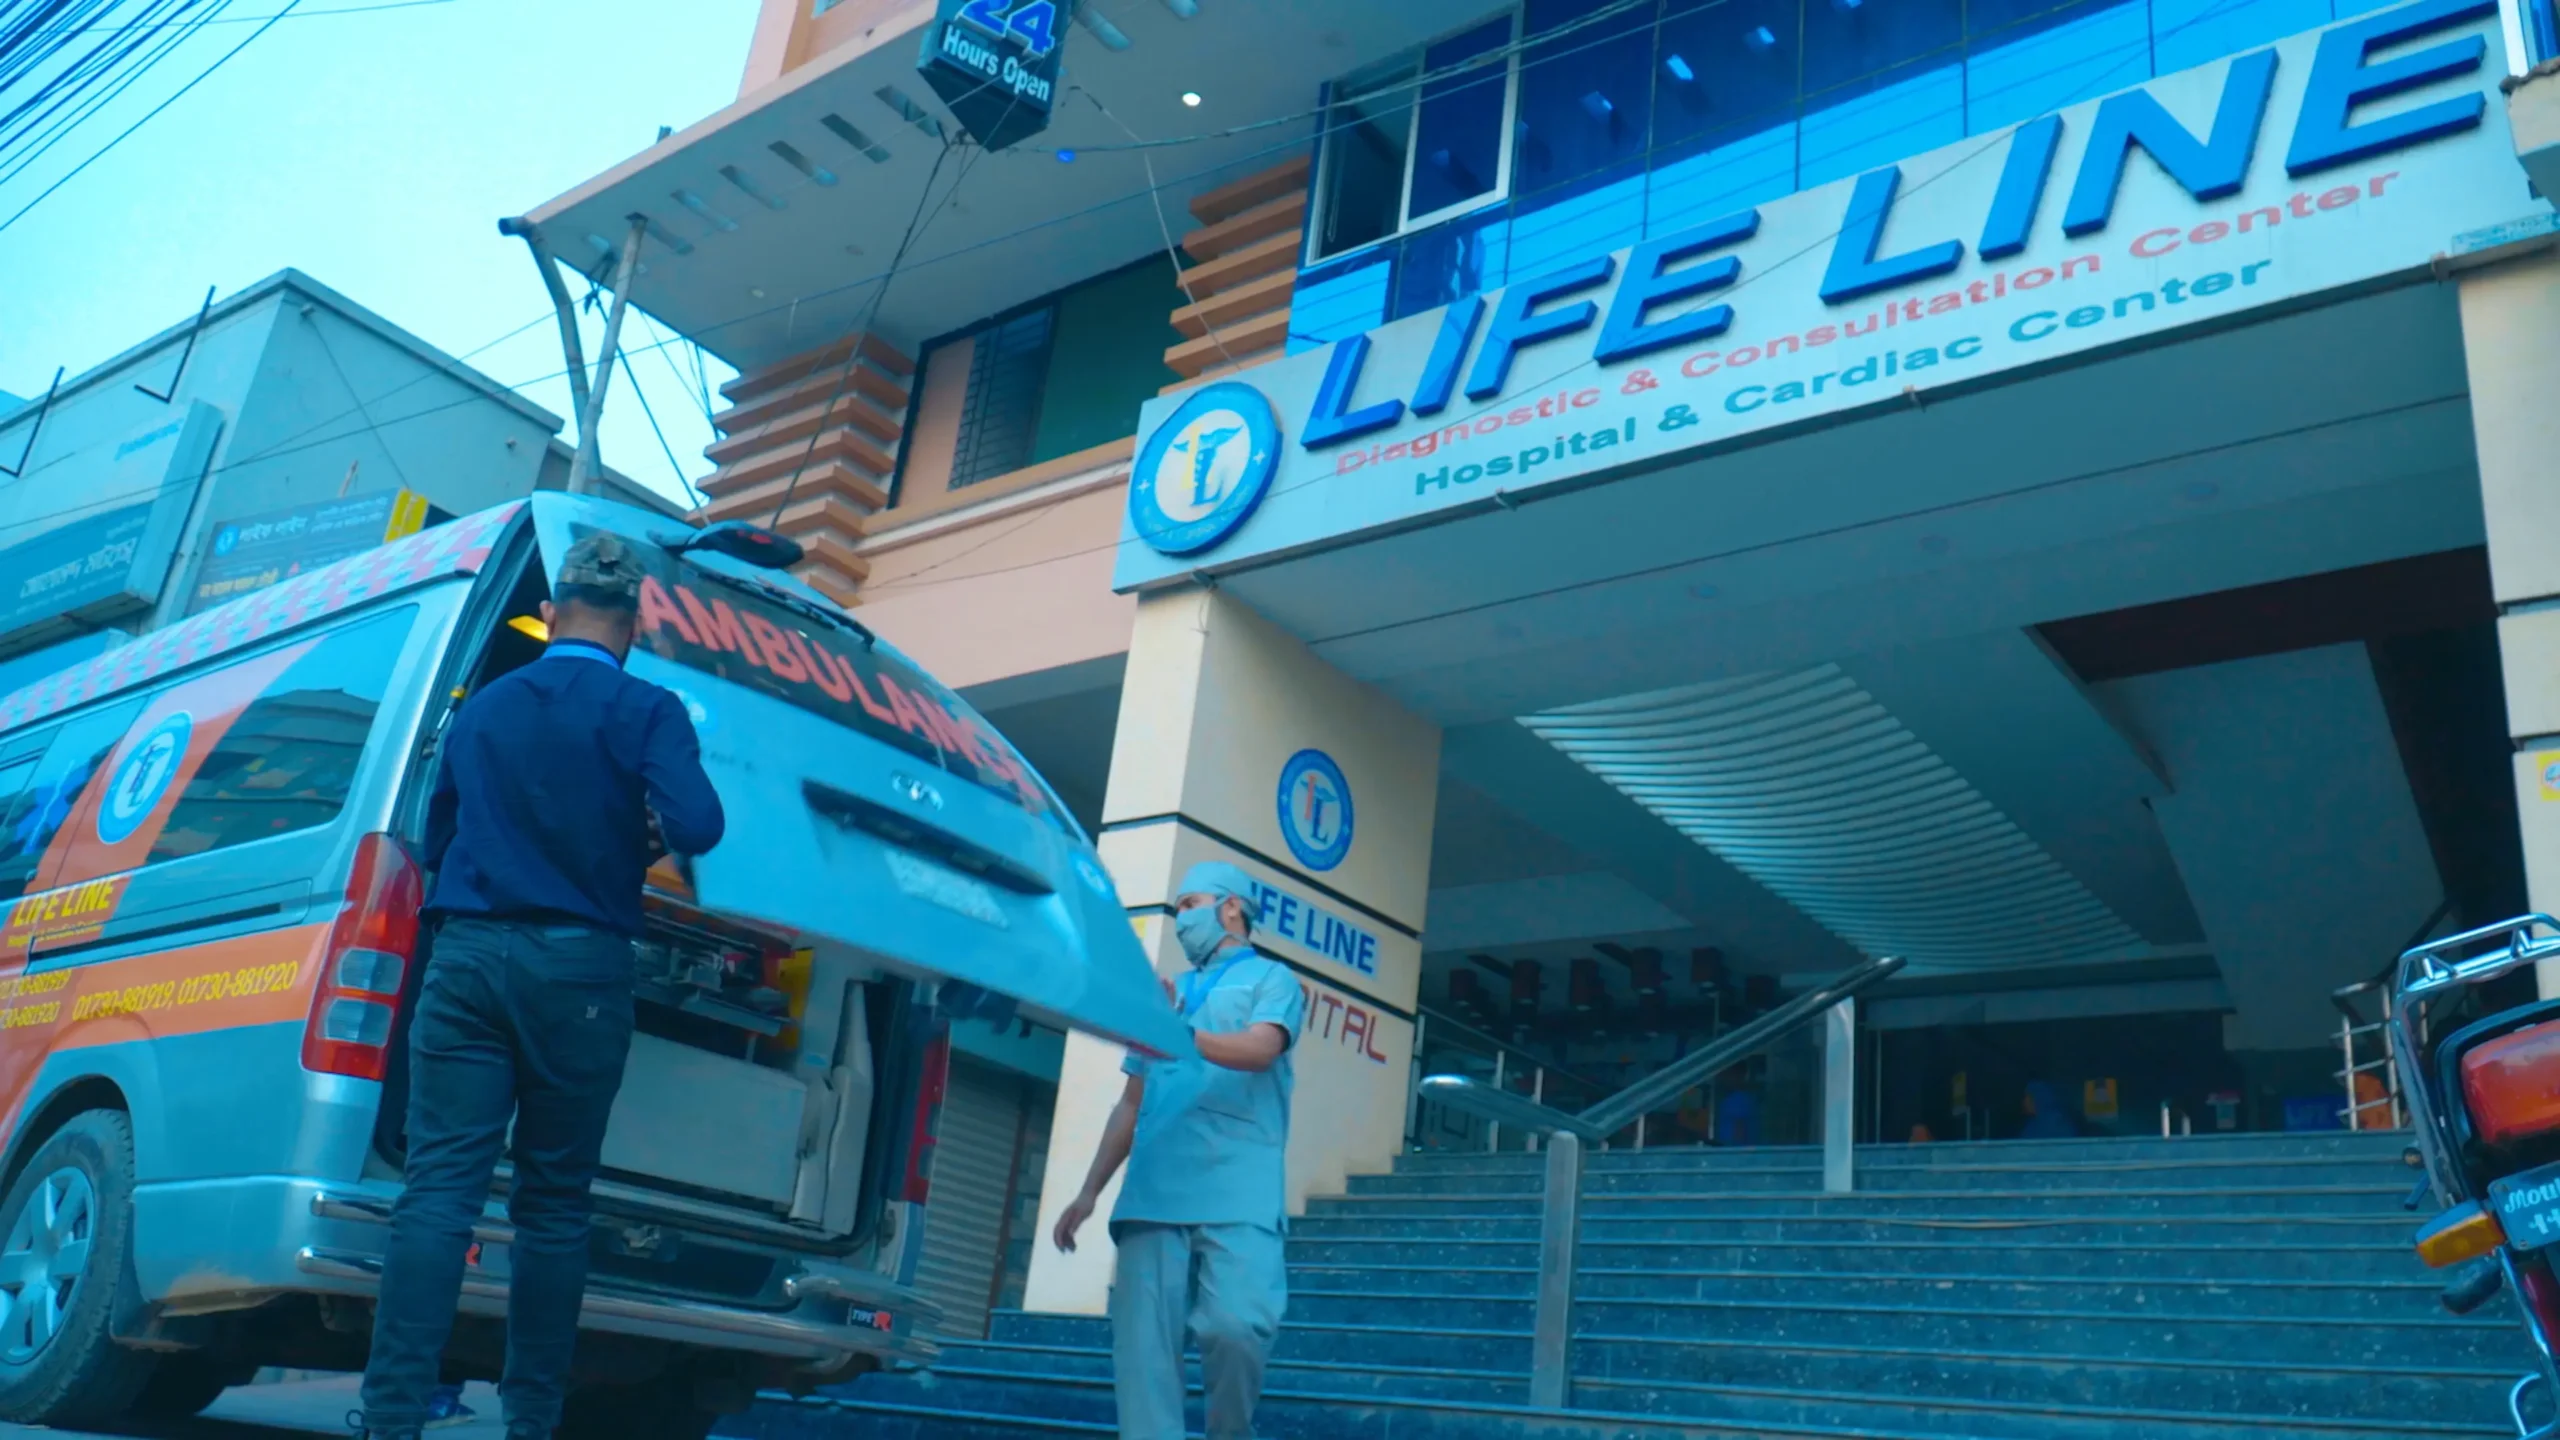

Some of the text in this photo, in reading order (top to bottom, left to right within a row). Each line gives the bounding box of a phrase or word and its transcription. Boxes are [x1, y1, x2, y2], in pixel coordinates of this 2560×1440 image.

[942, 25, 1050, 101] Hours Open
[955, 0, 1056, 58] 24
[1300, 0, 2500, 450] LIFE LINE
[1336, 388, 1601, 477] Diagnostic
[1620, 369, 1659, 396] &
[1682, 254, 2101, 378] Consultation
[2129, 171, 2400, 257] Center
[1415, 258, 2272, 496] Hospital & Cardiac Center
[637, 574, 1048, 816] AMBULANCE
[13, 881, 114, 928] LIFE LINE
[1305, 908, 1375, 974] LINE
[177, 960, 298, 1005] 01730-881920
